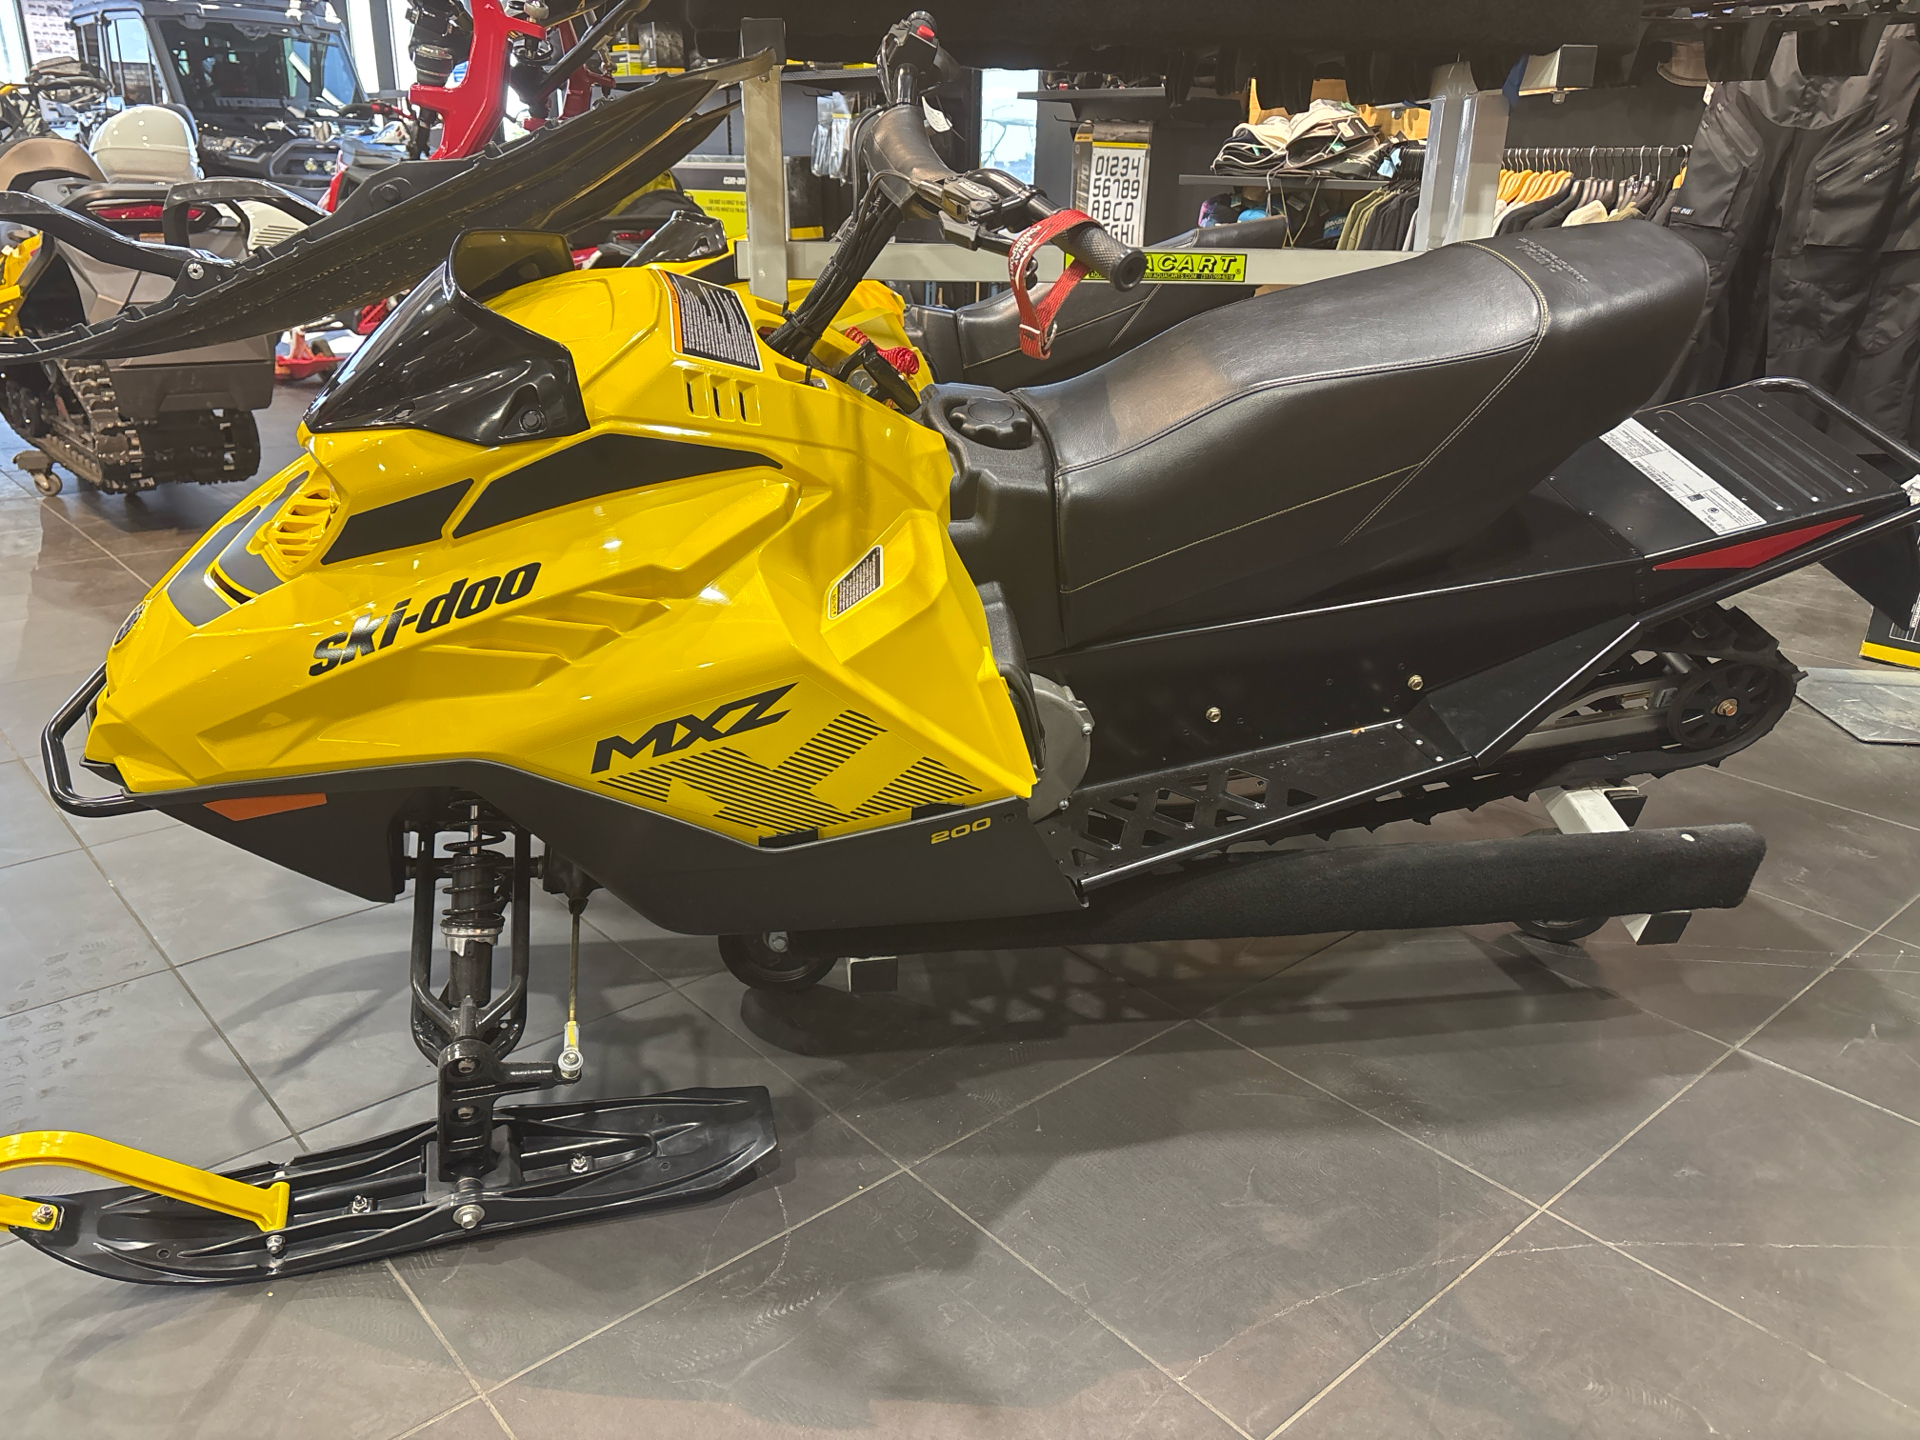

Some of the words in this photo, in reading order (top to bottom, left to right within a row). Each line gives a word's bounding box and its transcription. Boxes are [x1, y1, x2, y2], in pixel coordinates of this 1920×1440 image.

[1095, 155, 1141, 178] 01234
[1092, 177, 1141, 200] 56789
[1014, 237, 1033, 266] ELWAY
[309, 562, 542, 676] ski-doo
[590, 681, 799, 774] MXZ
[930, 817, 992, 844] 200
